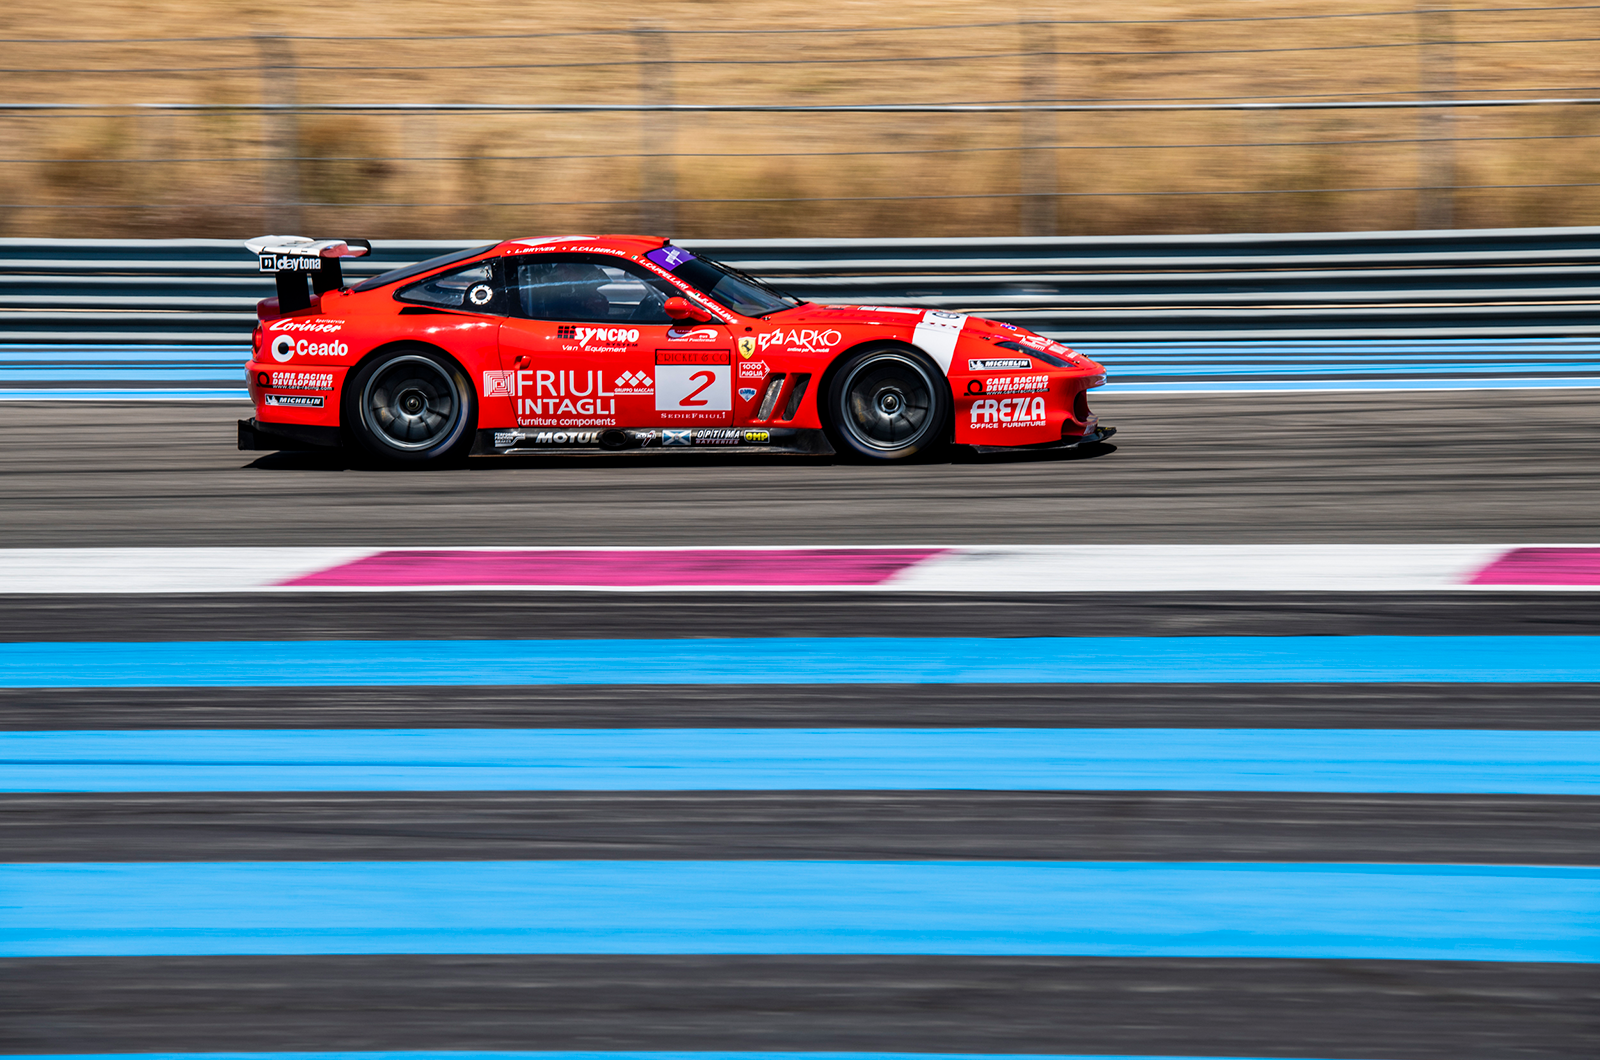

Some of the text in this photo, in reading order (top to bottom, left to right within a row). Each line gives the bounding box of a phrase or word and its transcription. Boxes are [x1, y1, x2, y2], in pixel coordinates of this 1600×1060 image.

[277, 256, 321, 271] daytona
[269, 318, 342, 333] Lorinser
[574, 327, 640, 348] SYNCRO
[784, 329, 842, 353] ARKO
[296, 339, 348, 356] Ceado
[584, 345, 627, 353] Equipment
[657, 353, 729, 362] CRICKET & CO
[272, 372, 333, 381] CARE RACING
[986, 375, 1049, 385] CARE RACING
[272, 379, 333, 387] DEVELOPMENT
[517, 370, 614, 397] FRIUL
[679, 370, 716, 407] 2
[986, 382, 1049, 391] DEVELOPMENT
[279, 397, 321, 405] MICHELIN
[517, 399, 616, 415] INTAGLI
[970, 397, 1046, 422] FREZZA
[517, 417, 616, 427] furniture components
[535, 432, 600, 444] MOTUL
[697, 430, 740, 438] OPTIMA
[745, 432, 768, 441] OMP
